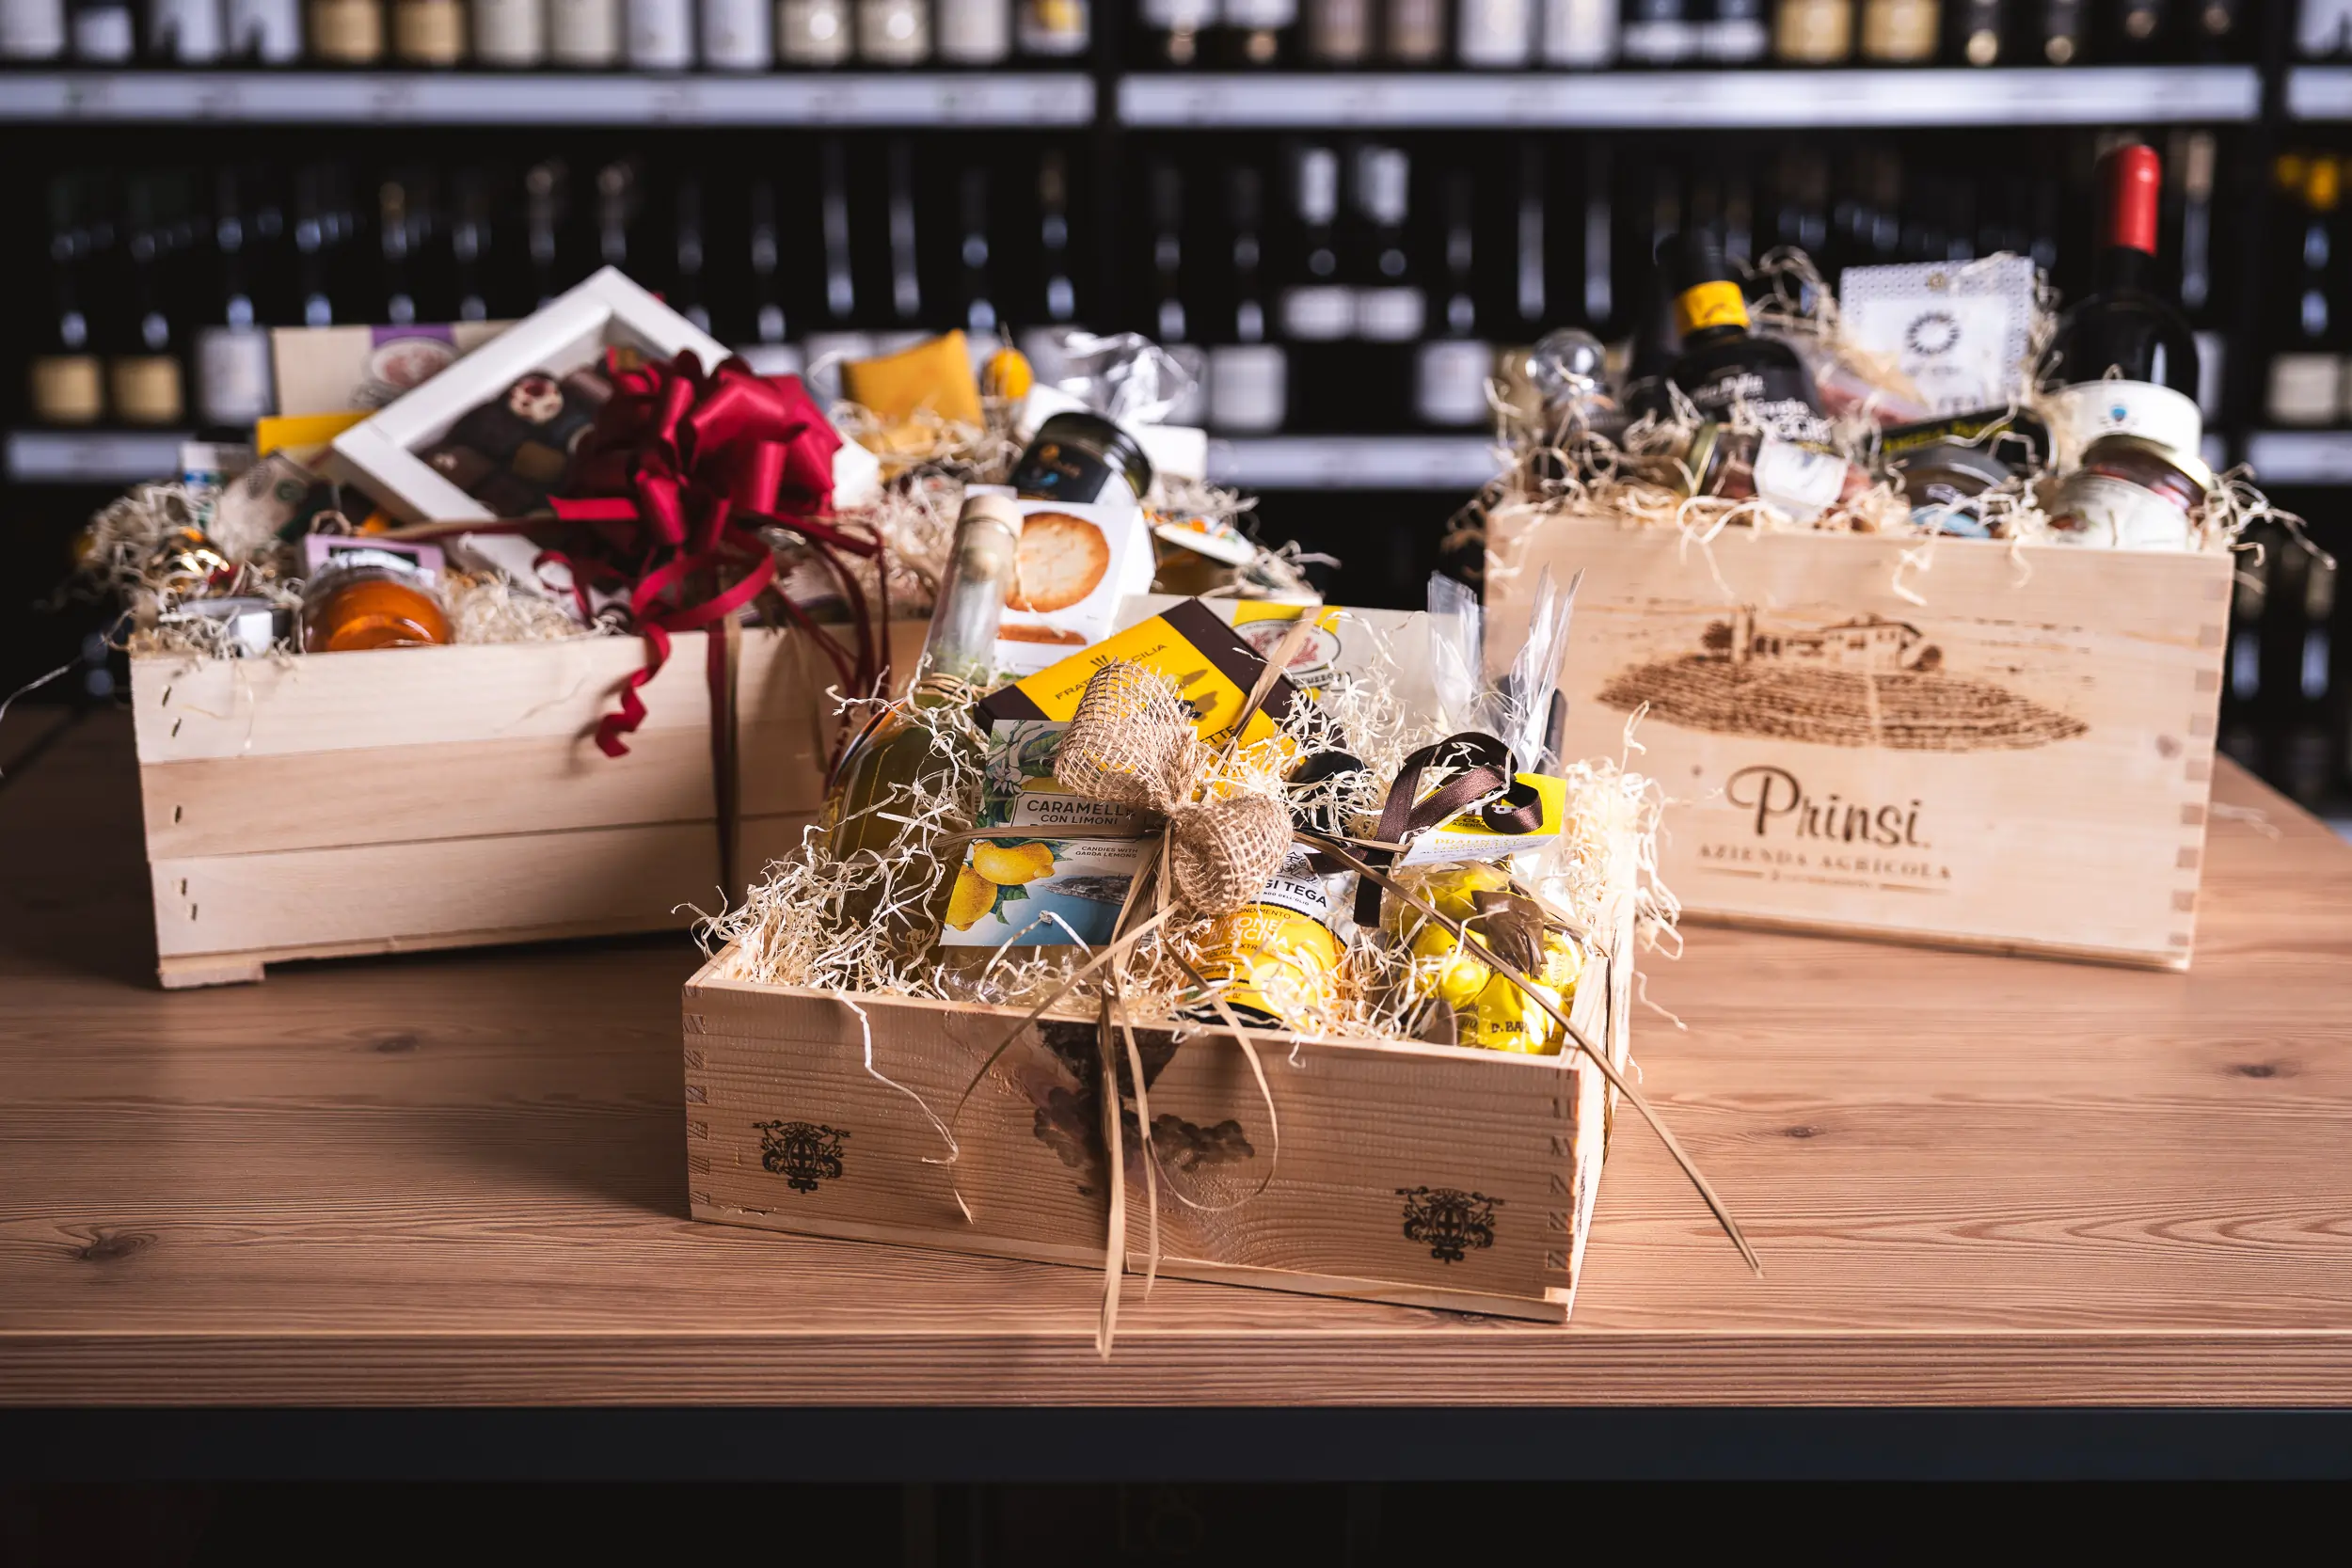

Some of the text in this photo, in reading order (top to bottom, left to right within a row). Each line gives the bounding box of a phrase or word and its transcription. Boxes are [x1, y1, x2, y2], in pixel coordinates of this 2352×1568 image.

[1041, 814, 1119, 825] CON LIMONI
[1284, 880, 1327, 908] TEGA
[1237, 907, 1292, 920] ONDIMENTO
